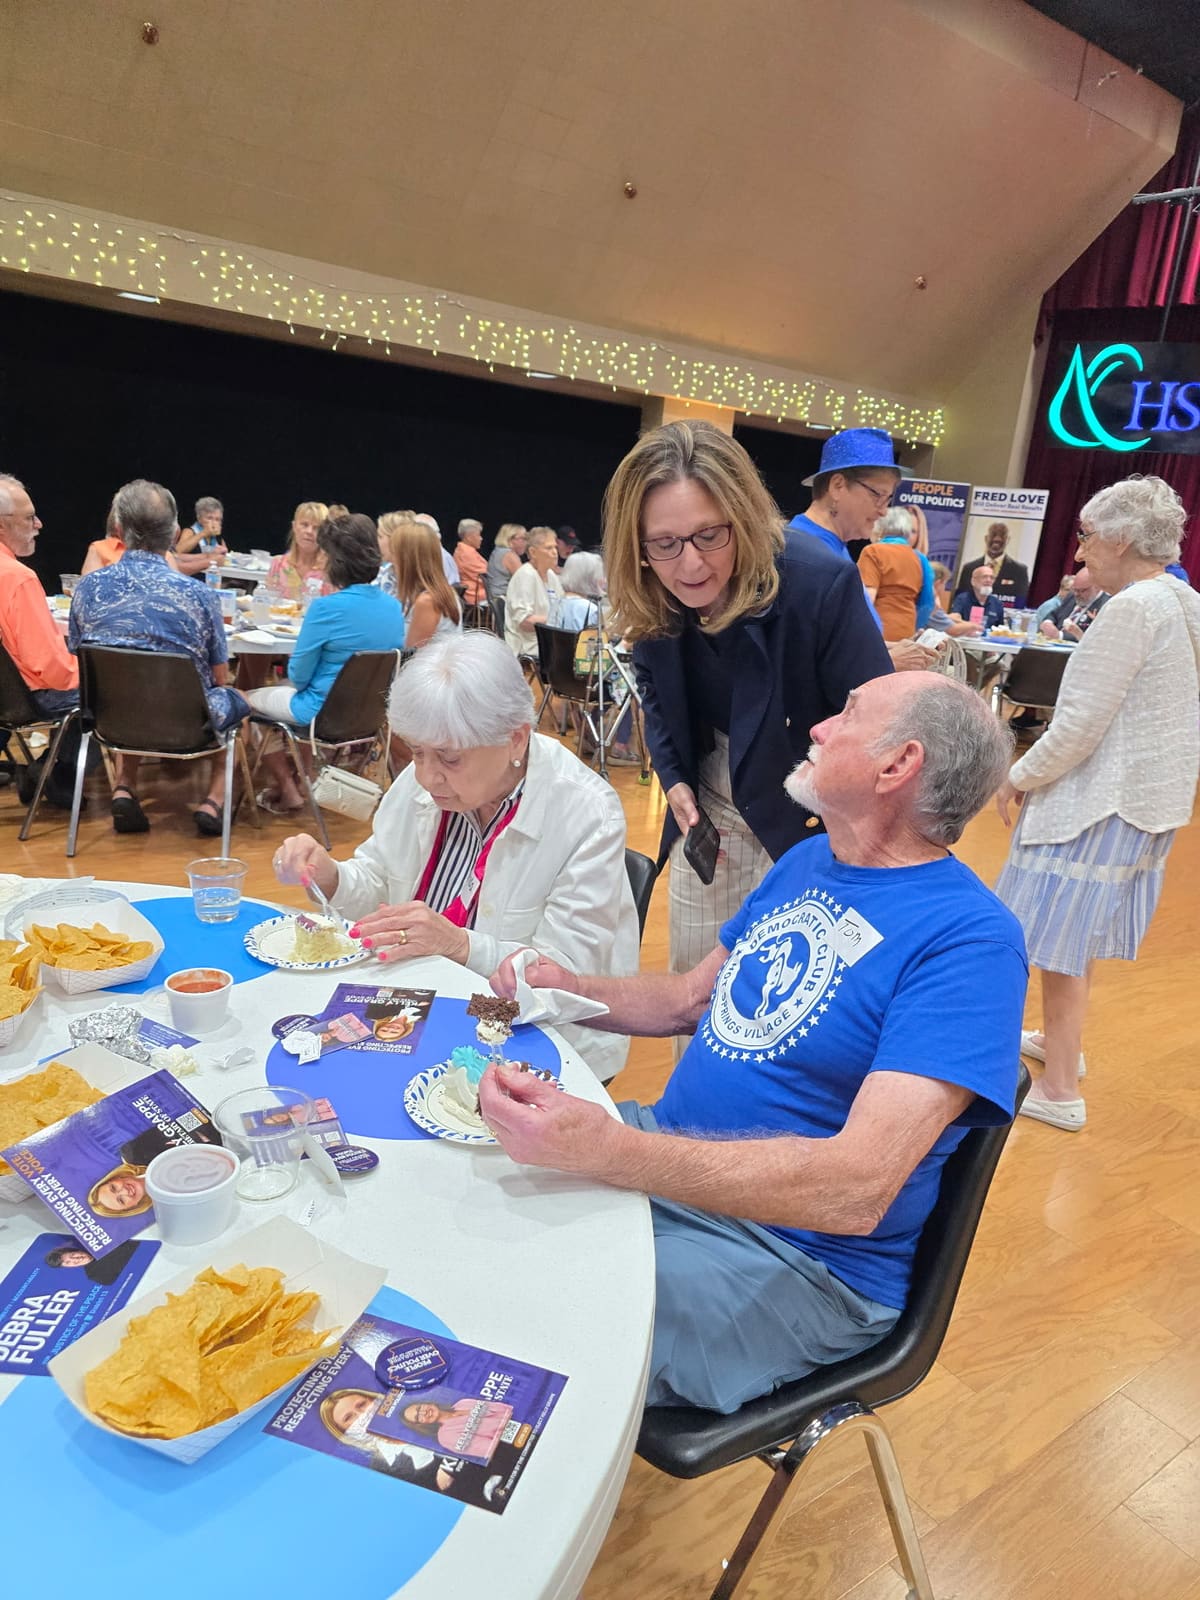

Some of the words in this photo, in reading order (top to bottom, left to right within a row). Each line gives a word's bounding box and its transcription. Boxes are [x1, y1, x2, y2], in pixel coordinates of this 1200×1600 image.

[900, 493, 925, 505] OVER
[926, 496, 965, 508] POLITICS
[912, 482, 954, 496] PEOPLE
[974, 491, 1007, 502] FRED
[1010, 492, 1046, 505] LOVE
[749, 912, 826, 950] DEMOCRATIC
[804, 944, 828, 992] CLUB
[722, 963, 737, 987] HOT
[720, 992, 742, 1035] SPRINGS
[744, 1009, 791, 1039] VILLAGE
[132, 1098, 175, 1137] GRAPPE
[30, 1177, 58, 1204] EVERY
[41, 1172, 69, 1200] EVERY
[54, 1200, 103, 1252] PROTECTING
[65, 1196, 112, 1246] RESPECTING
[8, 1290, 80, 1364] FULLER
[272, 1370, 323, 1428] PROTECTING
[283, 1375, 333, 1433] RESPECTING
[328, 1347, 354, 1376] EVERY
[494, 1374, 514, 1400] STATE
